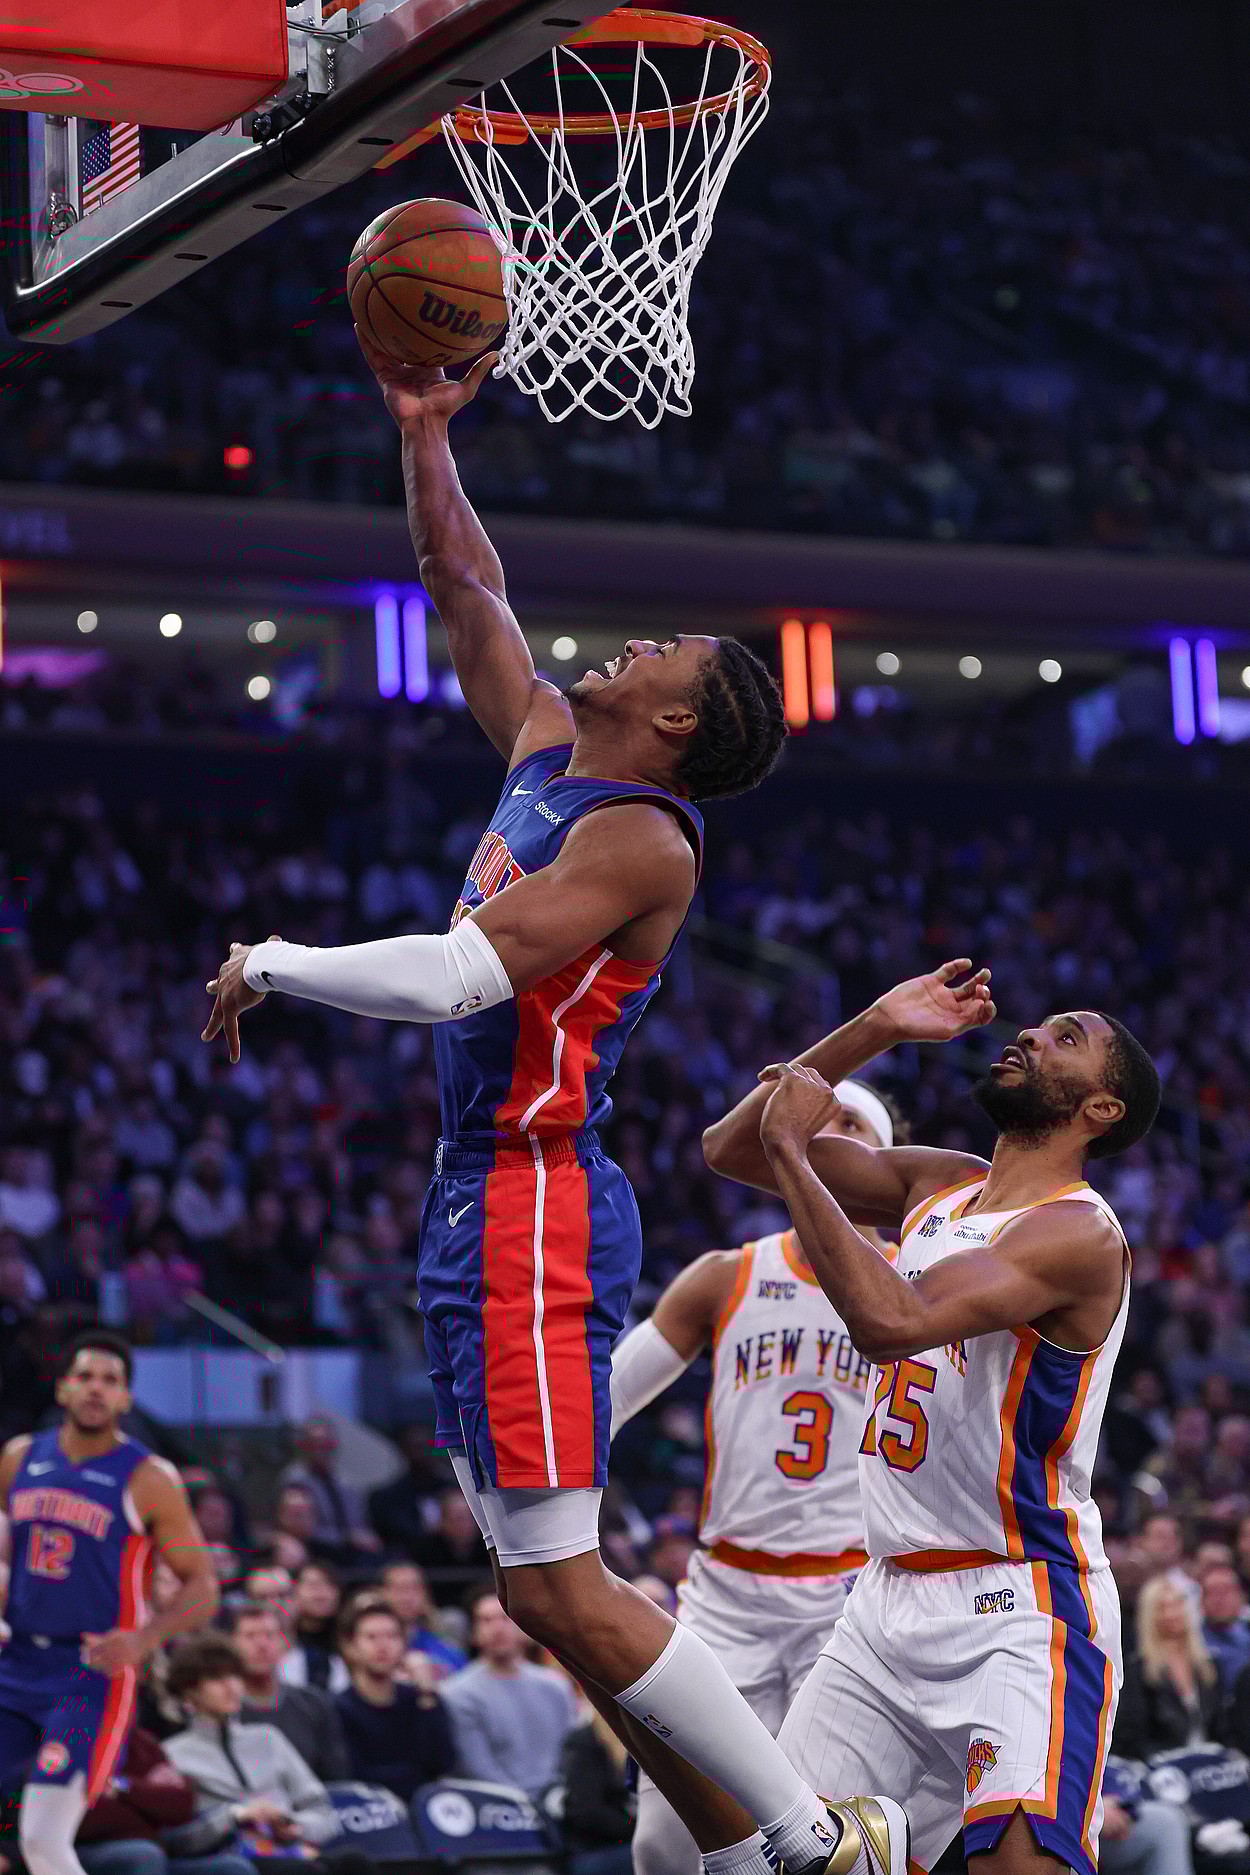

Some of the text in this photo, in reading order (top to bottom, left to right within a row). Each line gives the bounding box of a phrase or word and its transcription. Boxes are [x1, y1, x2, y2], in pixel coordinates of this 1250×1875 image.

[535, 801, 564, 826] StockX
[758, 1278, 798, 1300] NYC
[734, 1327, 805, 1392] NEW
[775, 1391, 834, 1481] 3
[26, 1522, 76, 1580] 12
[973, 1588, 1015, 1615] NYC
